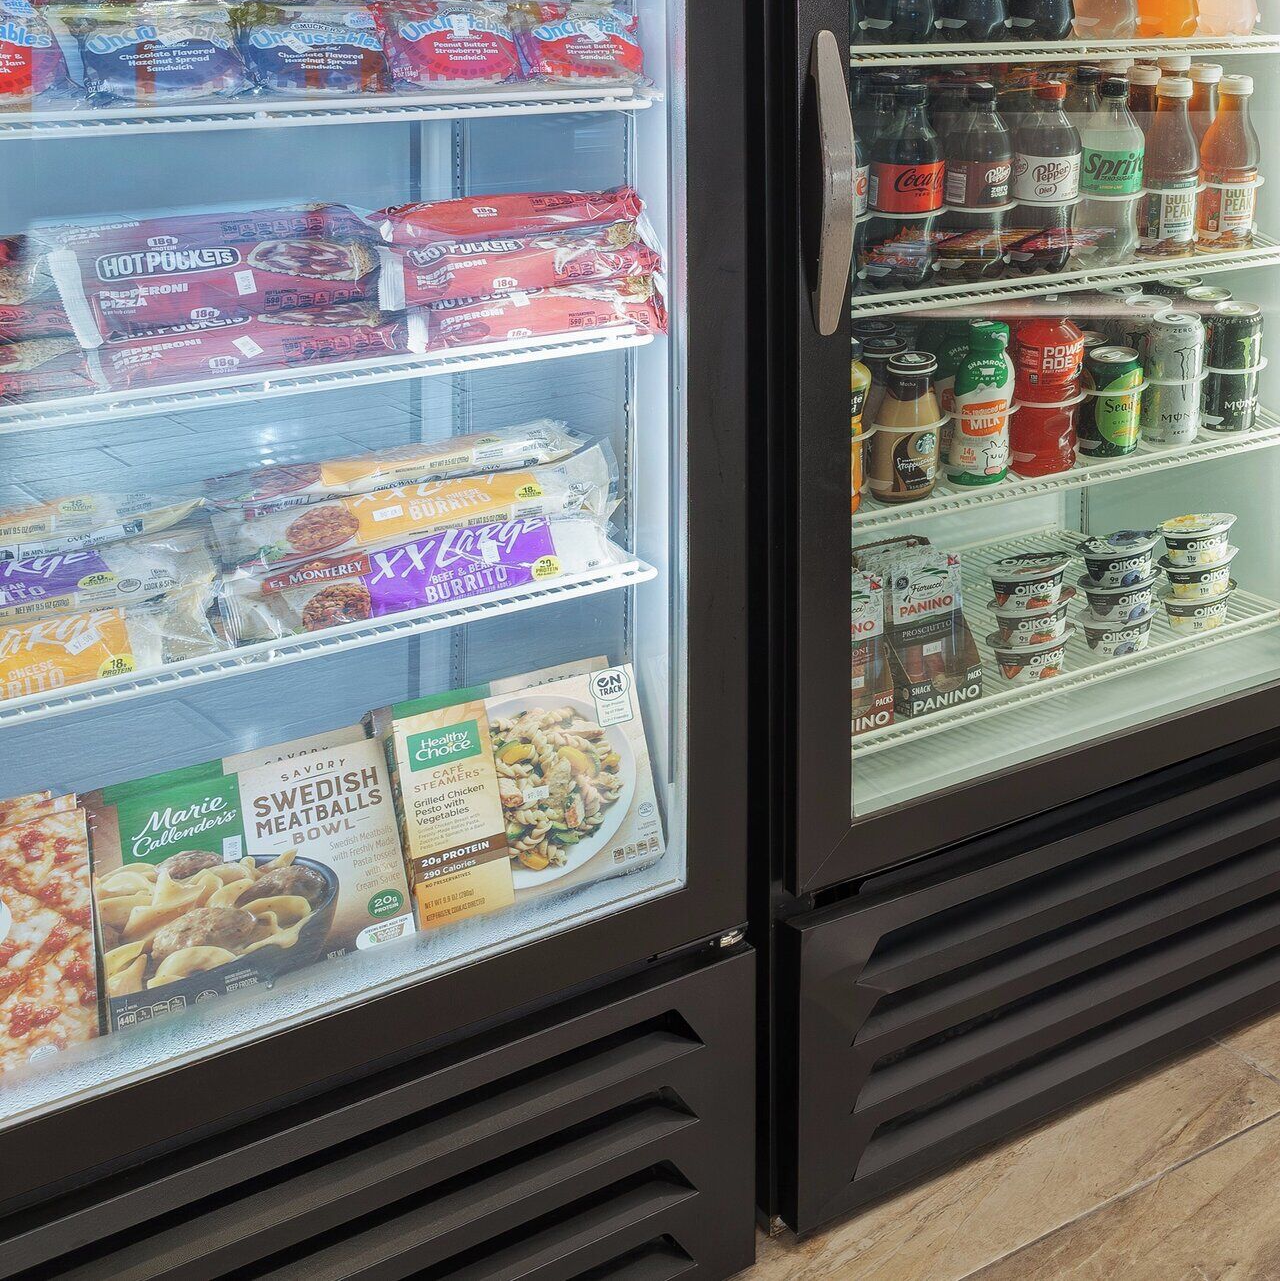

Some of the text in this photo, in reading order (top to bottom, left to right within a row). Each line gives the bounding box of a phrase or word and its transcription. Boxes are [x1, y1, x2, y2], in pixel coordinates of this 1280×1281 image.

[119, 47, 216, 60] Chocolate Flavored
[128, 55, 210, 66] Hazelnut Spread
[147, 64, 194, 72] Sandwich
[1034, 165, 1070, 182] Pepper
[1164, 204, 1193, 218] PEAK
[102, 248, 233, 277] HOT POCKETS
[100, 283, 189, 299] PEPPERONI
[100, 298, 148, 309] PIZZA
[1043, 357, 1072, 370] ADE
[409, 490, 492, 521] BURRITO
[1187, 537, 1222, 551] OIKOS
[1109, 556, 1145, 572] OIKOS
[269, 561, 363, 589] EL MONTEREY
[425, 566, 508, 603] BURRITO
[911, 581, 943, 595] Fiorucci
[1015, 580, 1054, 596] OIKOS
[900, 595, 953, 617] PANINO
[902, 620, 952, 638] PROSCIUTTO
[1102, 628, 1139, 642] OIKOS
[102, 666, 132, 676] PROTEIN
[599, 684, 623, 696] TRACK
[911, 669, 982, 696] SNACK PACKS
[875, 695, 893, 707] PACKS
[913, 684, 980, 715] PANINO
[421, 731, 468, 750] Healthy
[281, 758, 346, 782] SAVORY
[432, 763, 464, 780] CAFÉ
[414, 770, 479, 793] STEAMERS
[253, 766, 379, 818] SWEDISH
[414, 783, 485, 809] Grilled Chicken
[255, 789, 383, 839] MEATBALLS
[415, 797, 465, 818] Pesto with
[416, 806, 470, 826] Vegetables
[132, 795, 228, 842] Marie
[132, 809, 237, 857] Callender's
[293, 821, 355, 846] BOWL
[329, 825, 393, 850] Swedish Meatballs
[421, 840, 490, 868] 20g PROTEIN
[424, 859, 477, 880] 290 Calories
[433, 871, 471, 886] PRESERVATIVES
